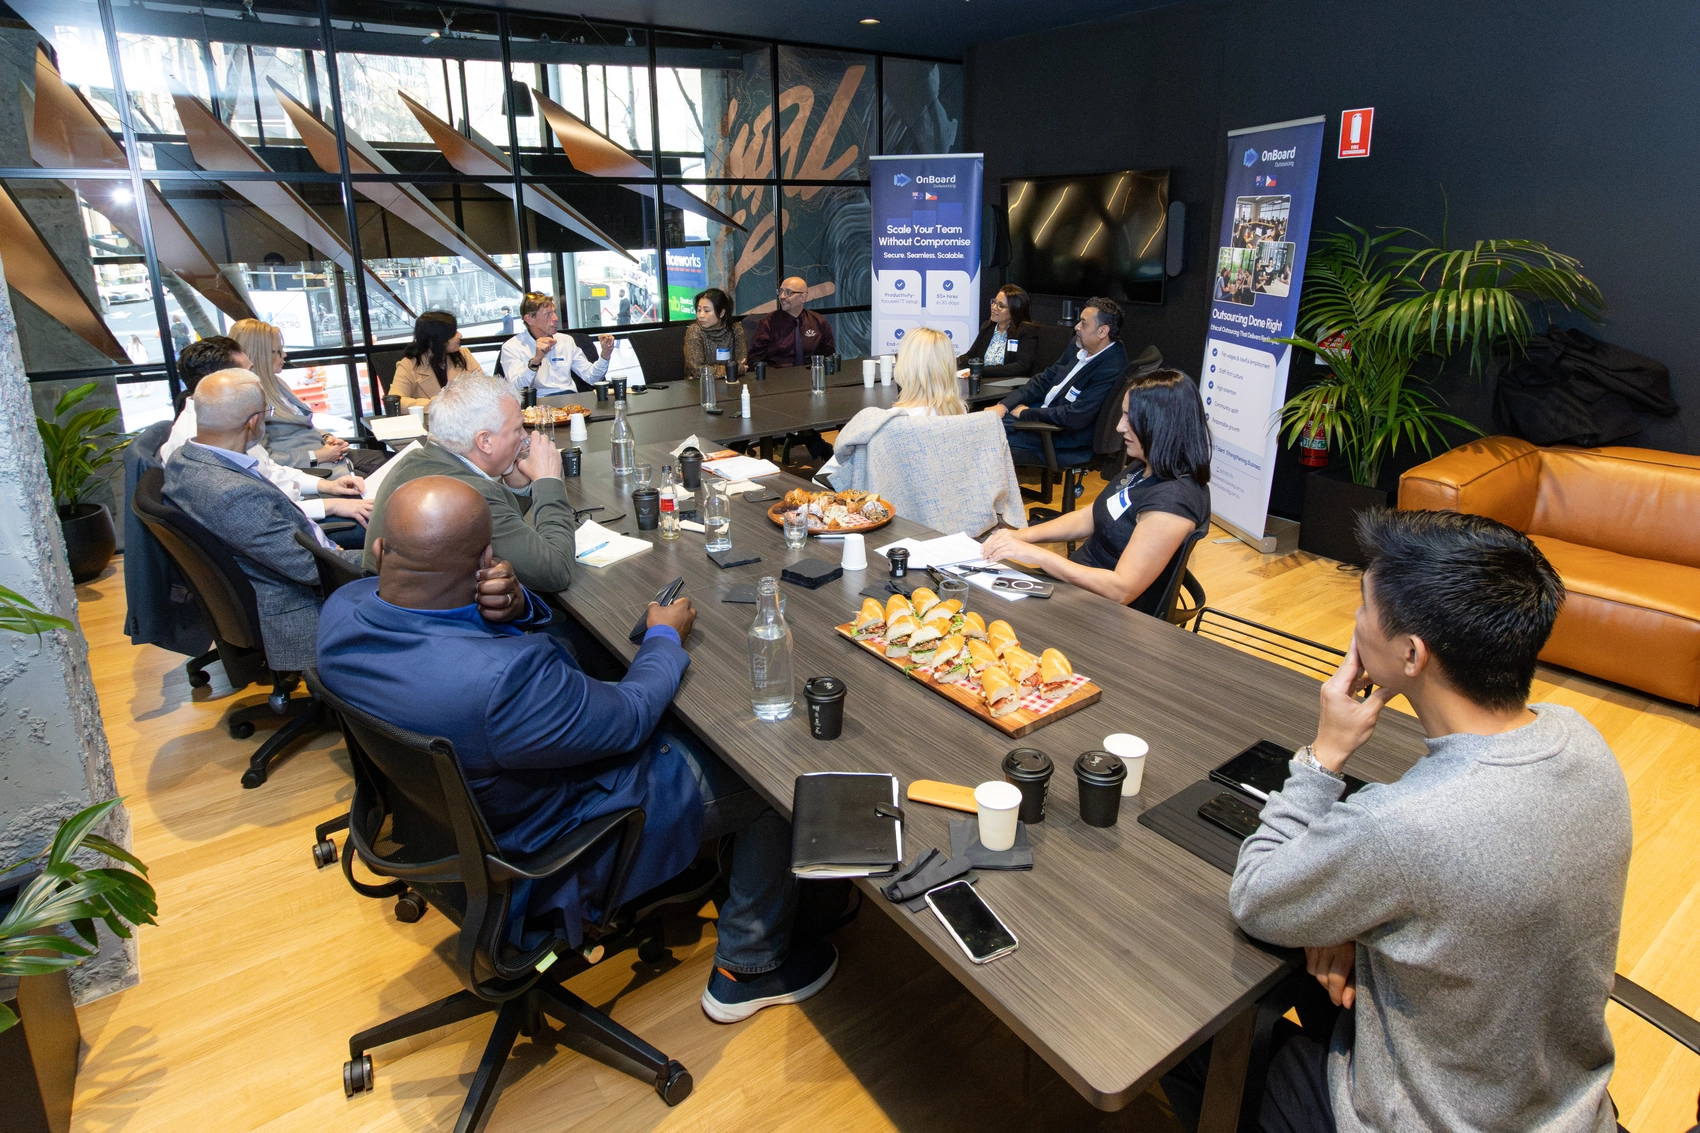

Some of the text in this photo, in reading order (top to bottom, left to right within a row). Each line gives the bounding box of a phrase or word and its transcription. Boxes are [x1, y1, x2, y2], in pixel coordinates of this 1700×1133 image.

[1261, 146, 1296, 162] OnBoard
[916, 174, 956, 184] OnBoard
[886, 224, 962, 234] Scale Your Team
[878, 236, 971, 249] Without Compromise
[666, 250, 701, 268] ficeworks
[883, 251, 965, 259] Secure. Seamless. Scalable.
[1212, 308, 1283, 333] Outsourcing Done Right
[1210, 323, 1222, 332] Ethical
[1221, 326, 1240, 337] Outsourcing
